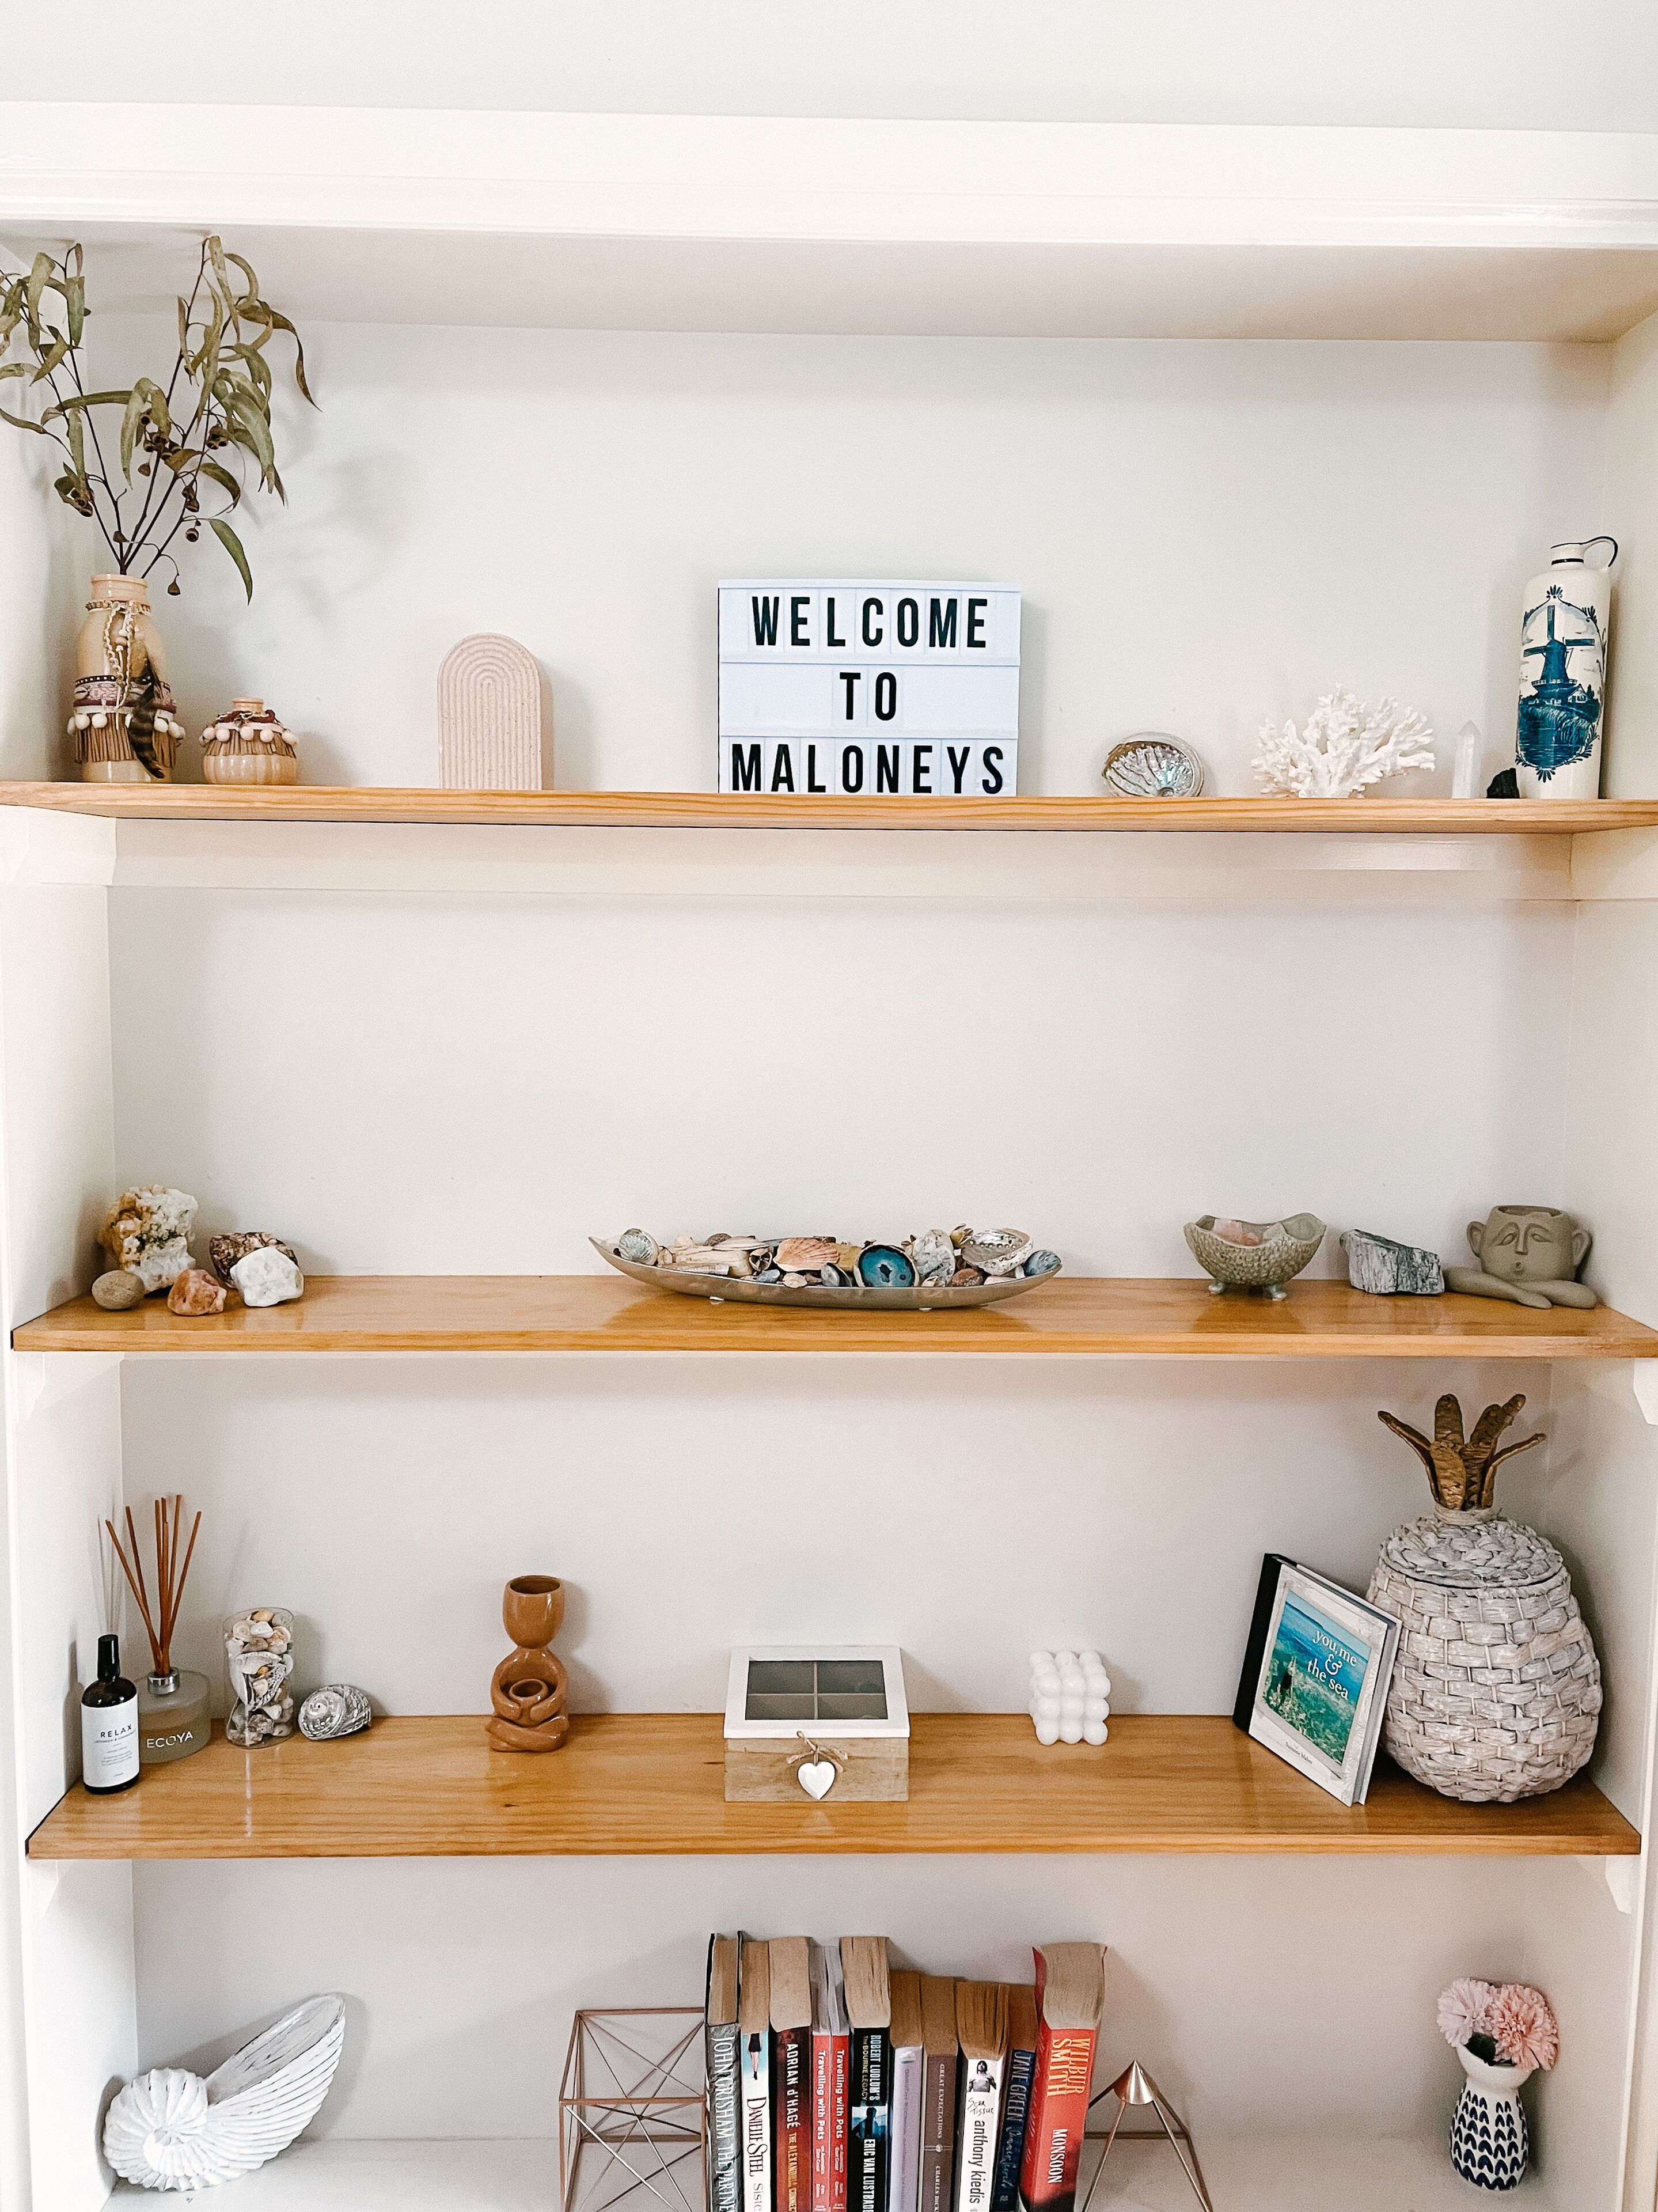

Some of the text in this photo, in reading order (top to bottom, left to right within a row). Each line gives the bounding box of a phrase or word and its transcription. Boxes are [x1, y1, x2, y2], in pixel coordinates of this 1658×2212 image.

[752, 596, 988, 648] WELCOME
[839, 671, 897, 721] TO
[731, 743, 1004, 795] MALONEYS
[1325, 1653, 1343, 1676] &
[1339, 1647, 1357, 1666] me
[1307, 1658, 1348, 1701] the sea
[100, 1724, 132, 1738] RELAX
[146, 1730, 194, 1749] ECOYA
[786, 2043, 801, 2130] ADRIAN d'HAGÉ
[816, 2050, 826, 2096] Travelling
[835, 2049, 845, 2094] Travelling
[869, 2035, 882, 2101] ROBERT LUDLUM'S
[1006, 2051, 1033, 2122] JANE GREEN
[1046, 2037, 1072, 2097] SMITH
[1066, 2037, 1091, 2094] WILBUR
[711, 2036, 736, 2212] JOHN GRISHAM THE PARTNE
[817, 2098, 826, 2118] with
[836, 2096, 845, 2116] with
[936, 2088, 945, 2139] EXPECTATIONS
[746, 2096, 768, 2177] DANIELLE STEEL
[788, 2131, 798, 2145] THE
[817, 2119, 826, 2141] Pets
[836, 2119, 844, 2139] Pets
[863, 2138, 876, 2157] ERIC
[863, 2157, 875, 2173] VAN
[968, 2120, 988, 2204] anthony kiedis
[1047, 2128, 1068, 2184] MONSOON
[788, 2187, 798, 2212] CONNEC
